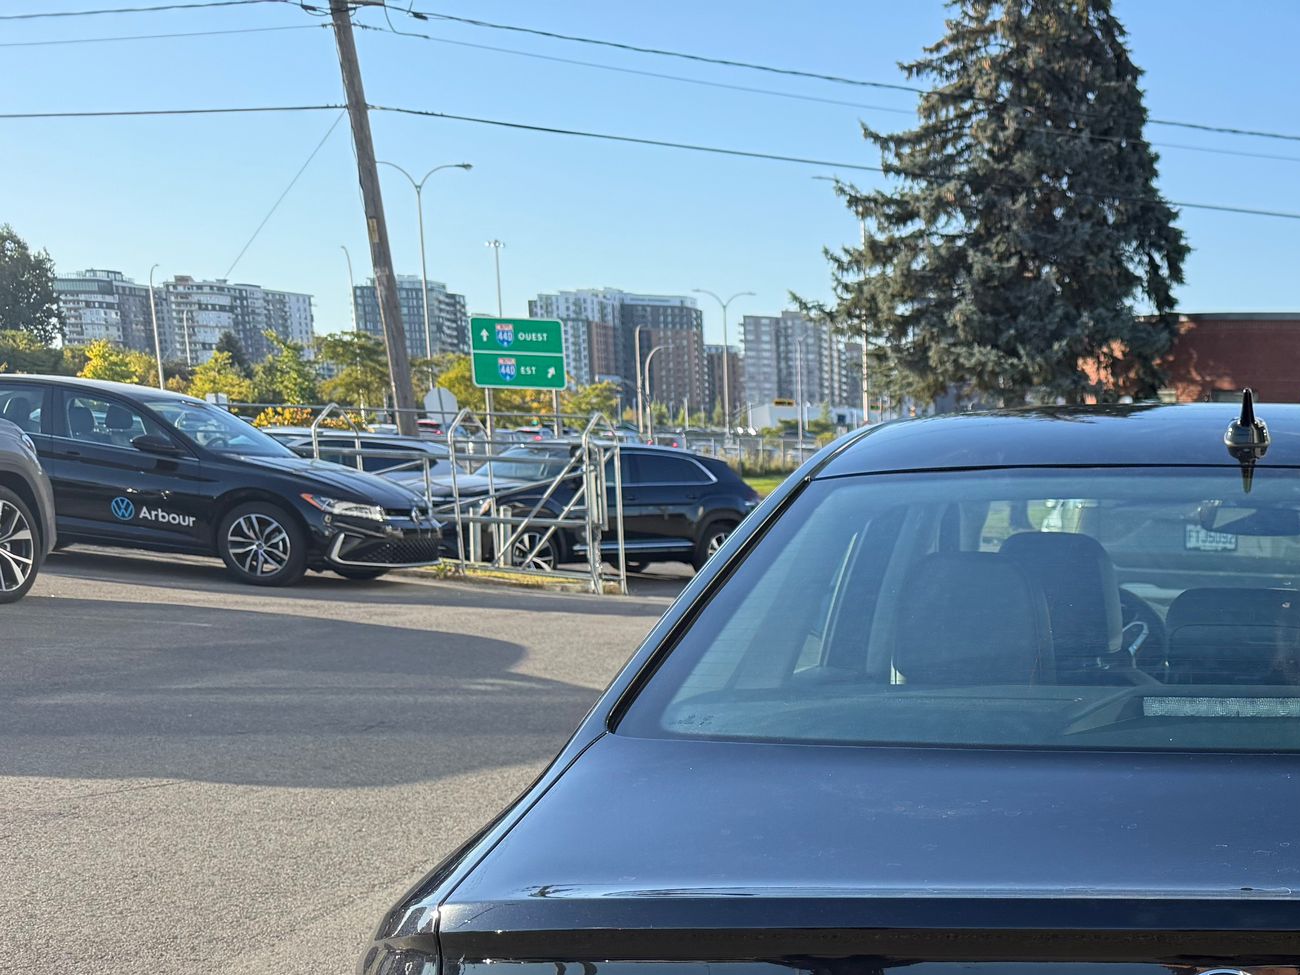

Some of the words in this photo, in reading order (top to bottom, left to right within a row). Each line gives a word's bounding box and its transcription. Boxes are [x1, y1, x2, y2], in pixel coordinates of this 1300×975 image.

[498, 331, 513, 341] 440
[518, 333, 548, 342] OUEST
[500, 366, 516, 376] 440
[520, 366, 537, 375] EST
[139, 506, 196, 527] Arbour
